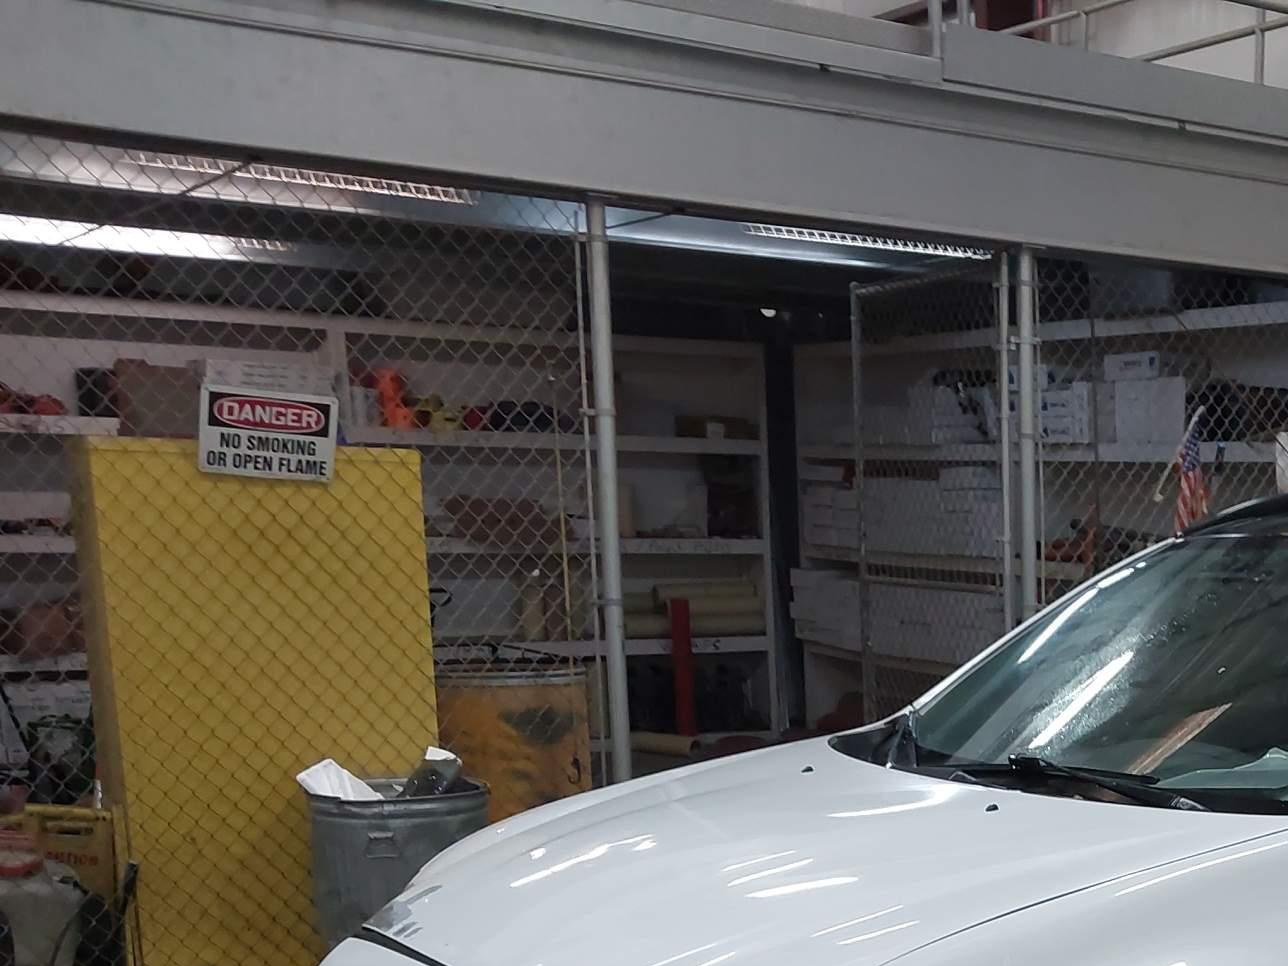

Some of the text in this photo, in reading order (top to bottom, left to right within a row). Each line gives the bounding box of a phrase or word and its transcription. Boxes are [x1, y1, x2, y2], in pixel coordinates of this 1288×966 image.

[221, 401, 318, 428] DANGER
[220, 432, 316, 456] NO SMOKING
[206, 450, 327, 476] OR OPEN FLAME
